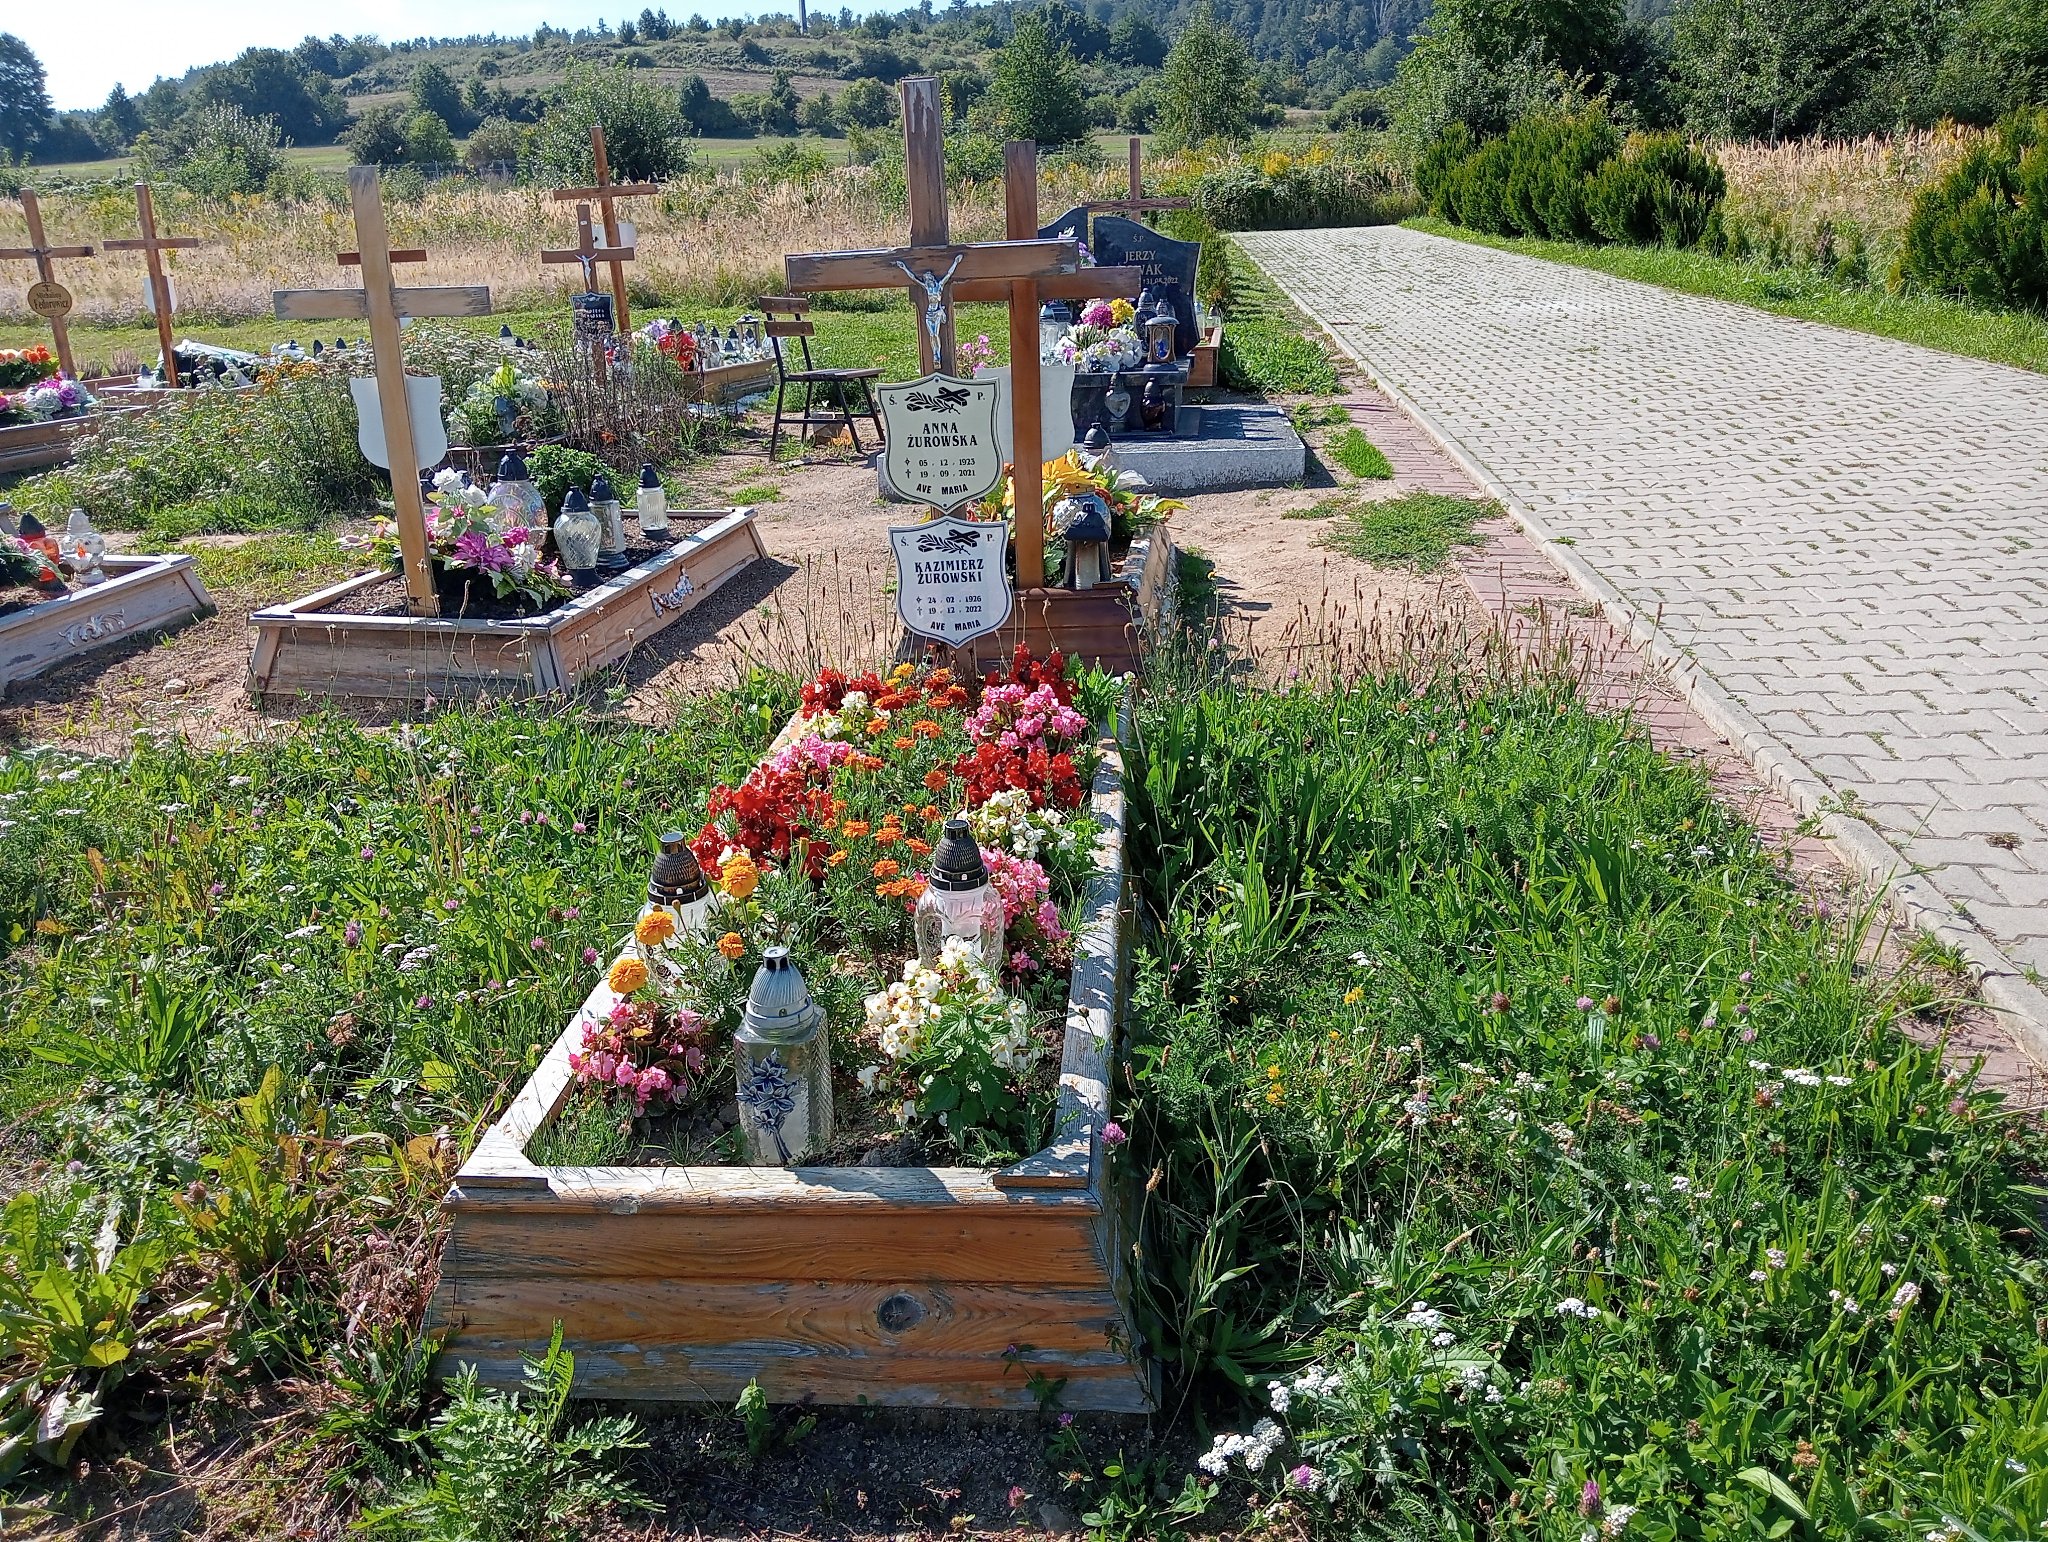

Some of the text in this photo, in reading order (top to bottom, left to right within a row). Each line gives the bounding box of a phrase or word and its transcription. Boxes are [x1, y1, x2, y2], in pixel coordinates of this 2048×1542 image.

[1124, 250, 1156, 264] JERZY
[922, 422, 959, 435] ANNA
[907, 434, 978, 448] ŻUROWSKA
[958, 469, 976, 477] 2021
[916, 483, 968, 495] AVE MARIA
[914, 558, 984, 573] KAZIMIERZ
[917, 570, 982, 585] ŻUROWSKI
[930, 619, 981, 632] AVE MARIA
